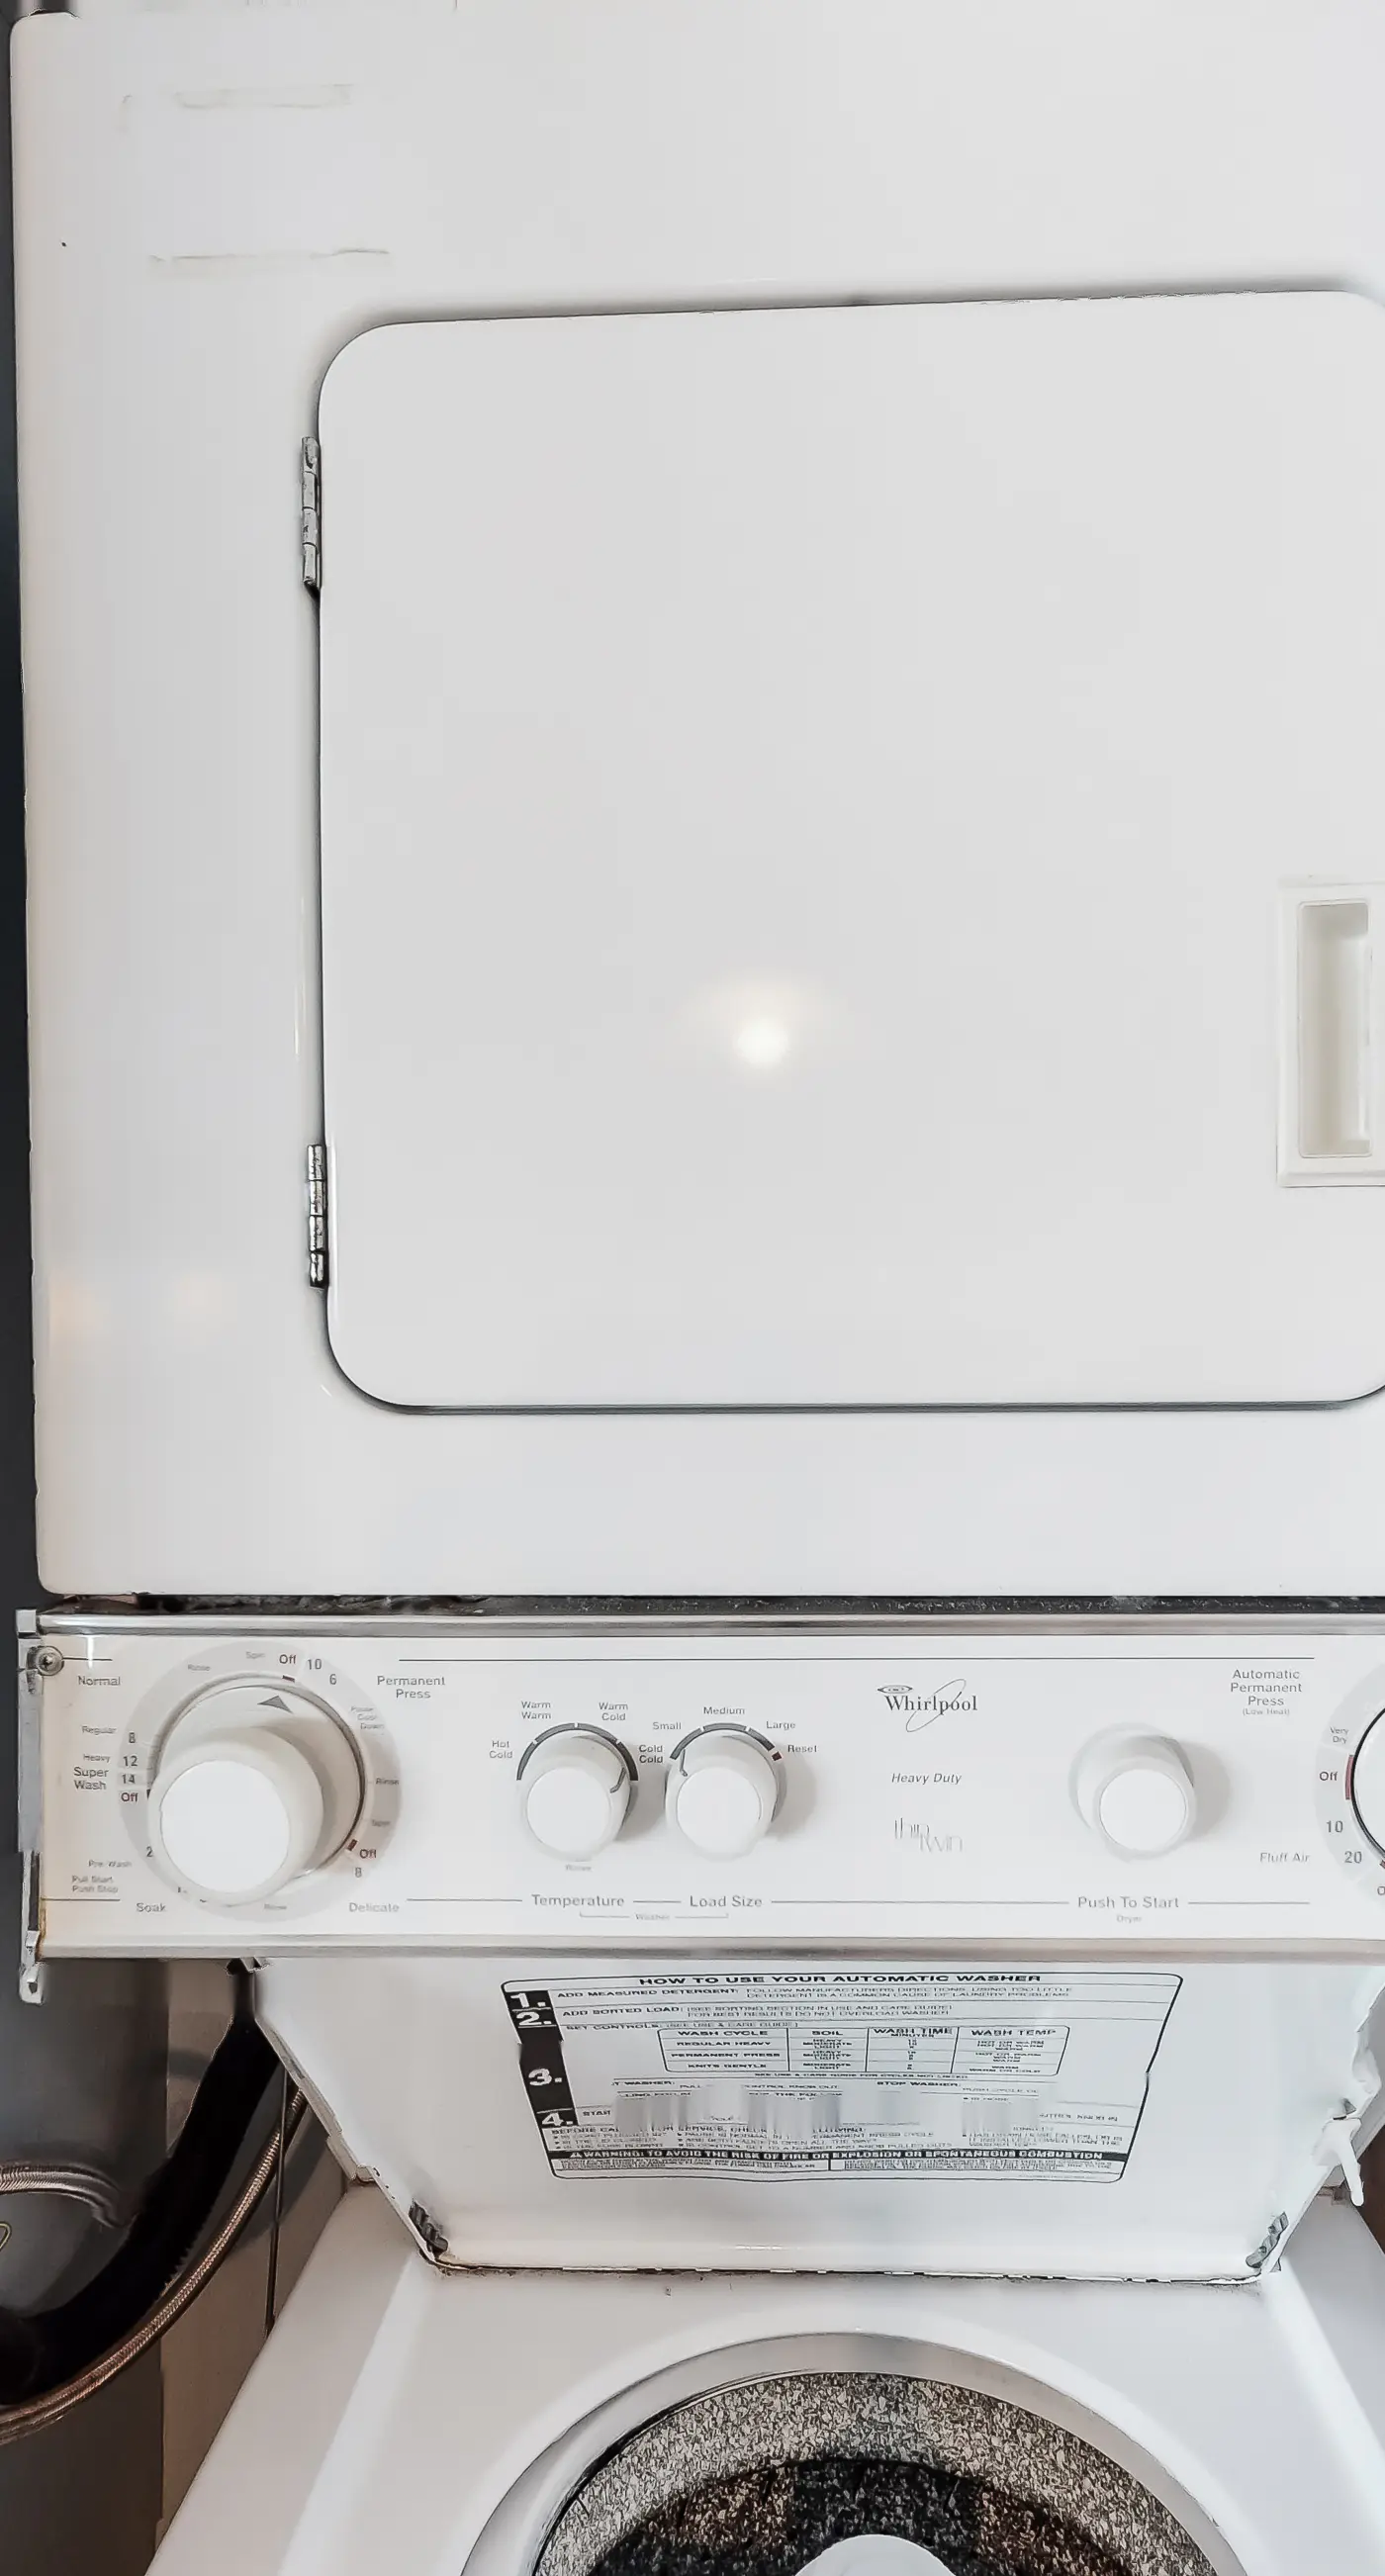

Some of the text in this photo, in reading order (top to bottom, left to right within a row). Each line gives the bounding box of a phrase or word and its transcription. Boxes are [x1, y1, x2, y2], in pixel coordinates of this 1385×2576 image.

[278, 1654, 297, 1665] Off
[307, 1659, 323, 1671] 10
[328, 1674, 337, 1686] 6
[1232, 1669, 1300, 1680] Automatic
[77, 1675, 121, 1686] Normal
[377, 1675, 446, 1686] Permanent
[396, 1688, 431, 1699] Press
[1230, 1683, 1303, 1694] Permanent
[520, 1701, 551, 1709] Warm
[598, 1702, 629, 1710] Warm
[883, 1695, 978, 1715] Whirlpool
[1247, 1696, 1285, 1706] Press
[520, 1711, 552, 1720] Warm
[601, 1711, 626, 1721] Cold
[703, 1706, 746, 1715] Medium
[652, 1721, 683, 1731] Small
[766, 1720, 796, 1732] Large
[128, 1732, 137, 1744] 8
[1333, 1735, 1347, 1745] Dry
[491, 1739, 510, 1749] Hot
[638, 1744, 664, 1754] Cold
[787, 1744, 818, 1754] Reset
[489, 1750, 513, 1760] Cold
[638, 1754, 664, 1764] Cold
[123, 1755, 138, 1767] 12
[73, 1766, 110, 1778] Super
[1319, 1771, 1339, 1782] Off
[122, 1774, 136, 1785] 14
[891, 1772, 963, 1785] Heavy Duty
[73, 1779, 107, 1791] Wash
[120, 1792, 138, 1802] Off
[1326, 1820, 1344, 1833] 10
[145, 1845, 154, 1858] 2
[359, 1849, 377, 1859] Off
[1259, 1852, 1311, 1864] Fluff Air
[1343, 1851, 1363, 1865] 20
[531, 1893, 625, 1908] Temperature
[690, 1894, 764, 1908] Load Size
[1077, 1895, 1179, 1909] Push To Start
[136, 1902, 167, 1913] Soak
[348, 1901, 400, 1913] Delicate
[832, 1975, 950, 1983] AUTOMATIC
[509, 1992, 546, 2008] 1.
[515, 2011, 553, 2026] 2.
[528, 2068, 562, 2085] 3.
[542, 2112, 574, 2127] 4.
[704, 2150, 730, 2159] THE
[832, 2151, 902, 2160] EXPLOSION
